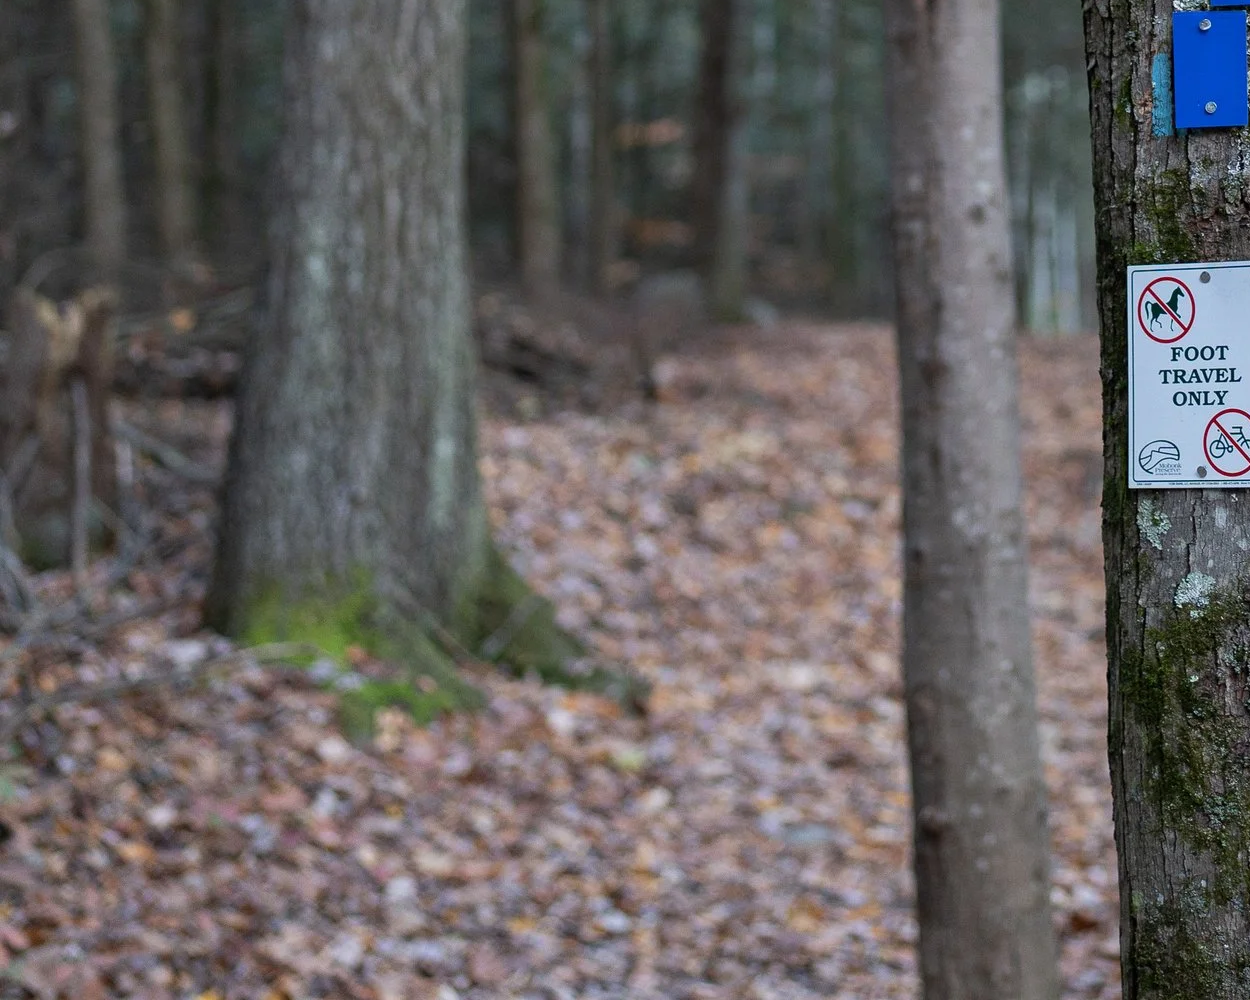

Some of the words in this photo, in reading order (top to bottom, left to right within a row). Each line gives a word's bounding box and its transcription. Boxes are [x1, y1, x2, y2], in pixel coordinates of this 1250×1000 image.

[1170, 345, 1230, 362] FOOT
[1158, 367, 1242, 384] TRAVEL
[1172, 390, 1229, 407] ONLY
